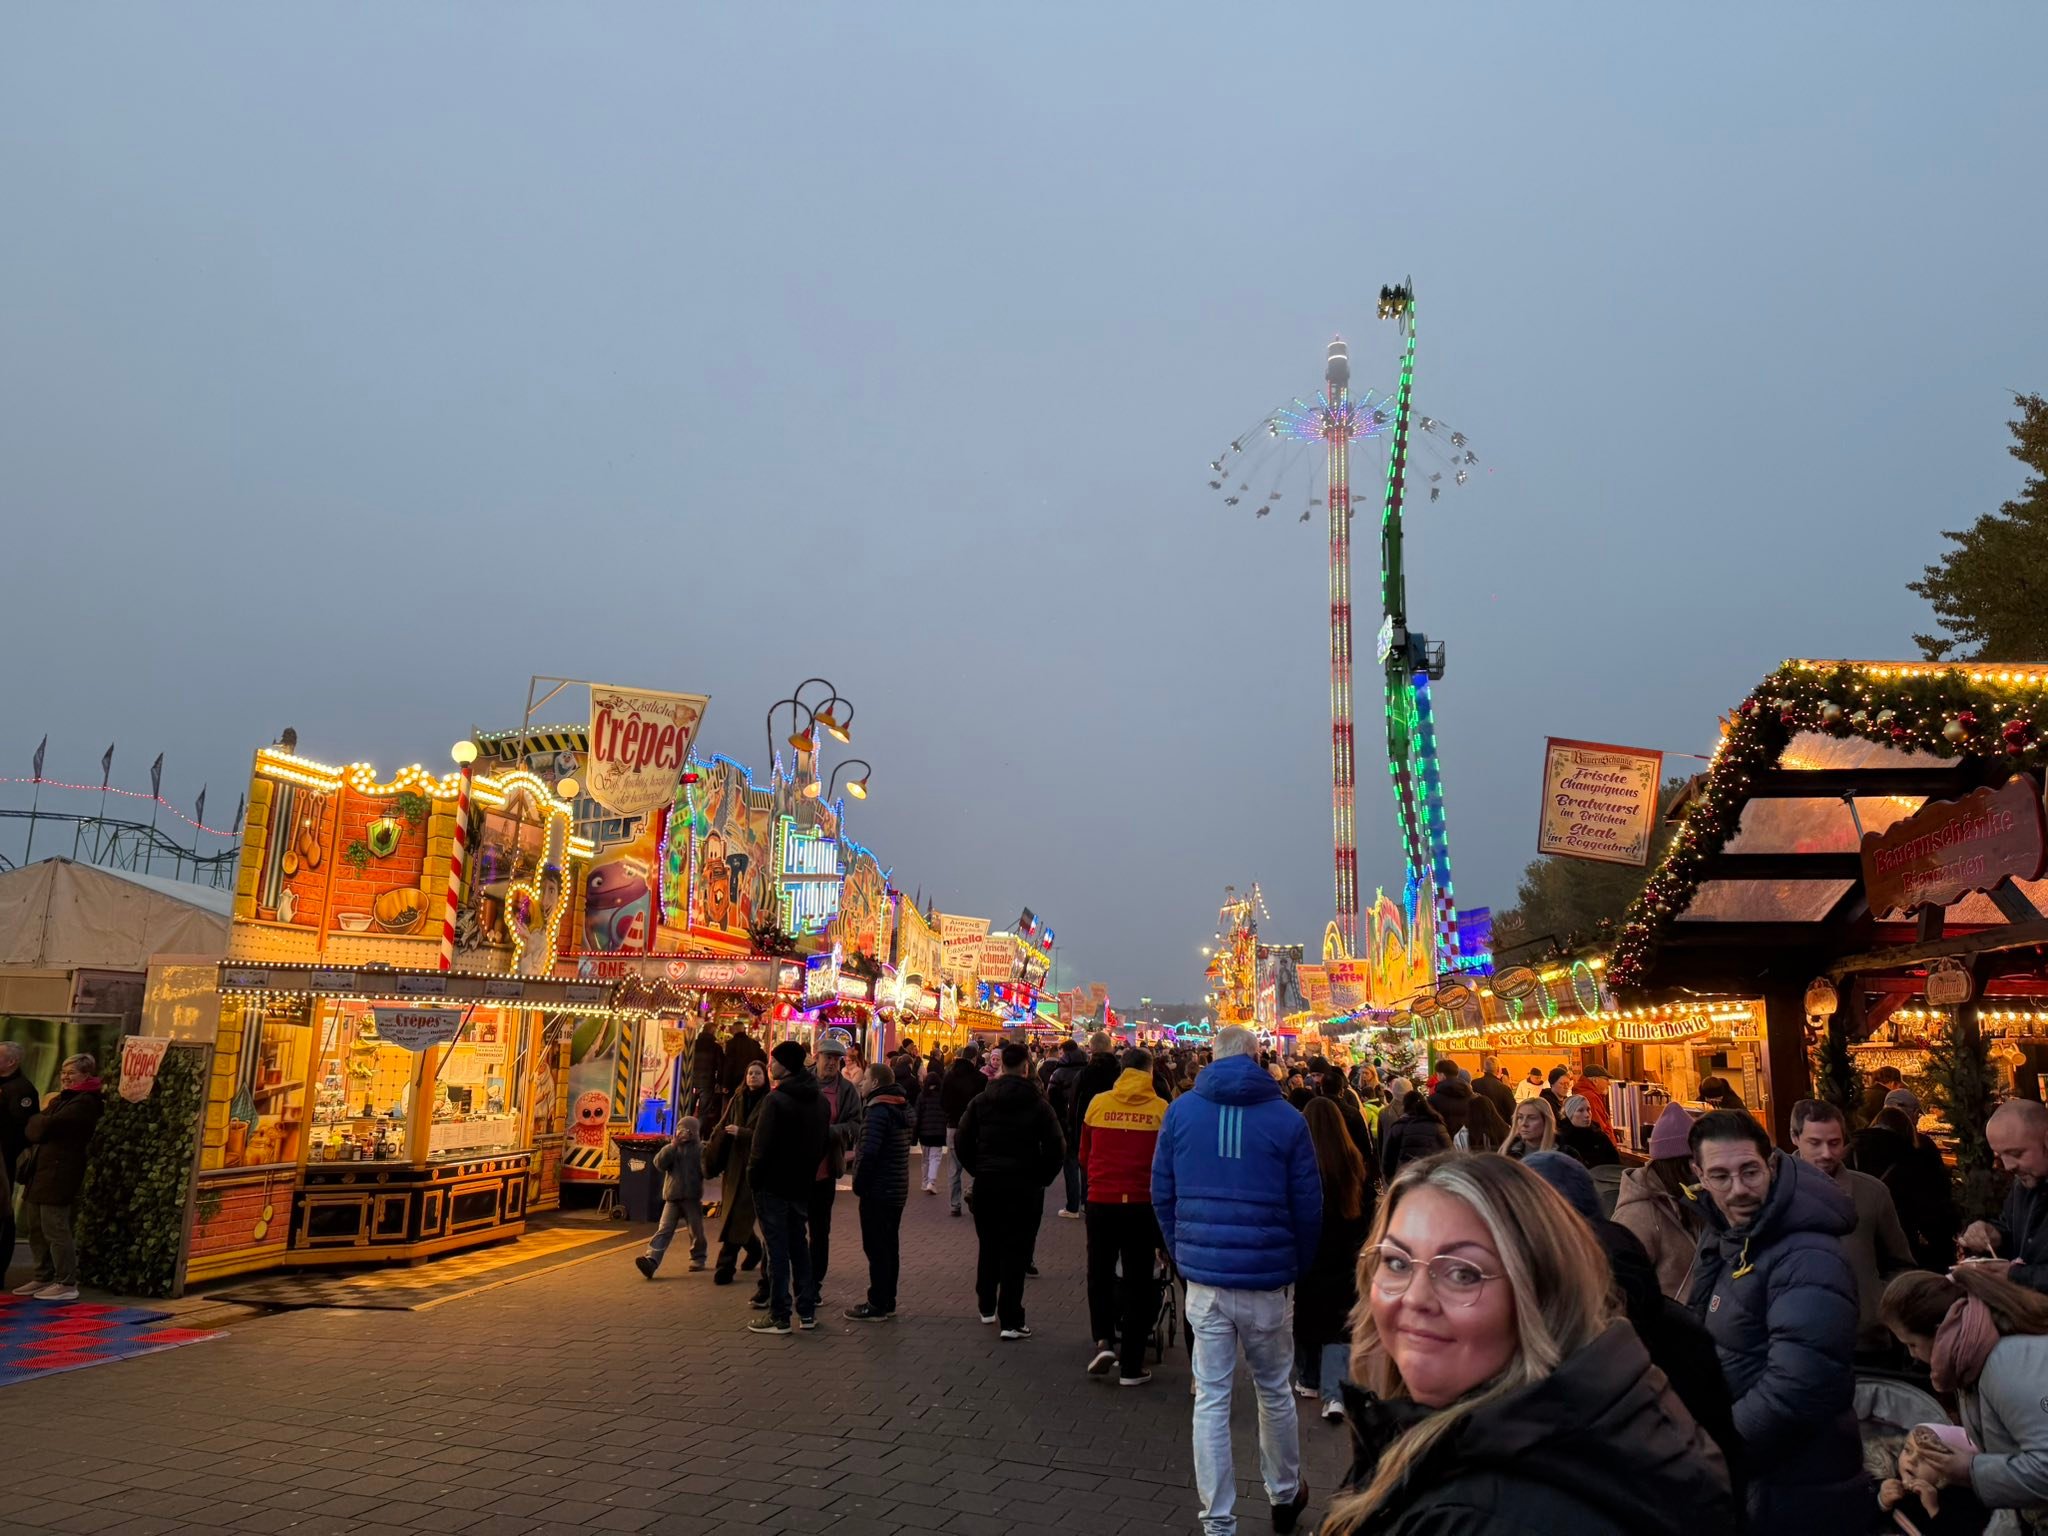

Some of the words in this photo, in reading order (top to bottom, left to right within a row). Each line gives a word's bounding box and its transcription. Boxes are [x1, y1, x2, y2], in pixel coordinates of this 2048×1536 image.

[594, 708, 690, 774] Crêpes
[1573, 767, 1627, 784] Frische
[1560, 778, 1639, 798] Champignons
[1555, 793, 1640, 816] Bratwurst
[1560, 807, 1574, 818] im
[1580, 810, 1627, 826] Brötchen
[1569, 823, 1617, 841] Steak
[1547, 833, 1562, 843] im
[1566, 835, 1637, 855] Roggenbrot
[1873, 808, 2015, 876] Bauernschänke
[943, 934, 983, 946] nutella
[701, 966, 735, 981] NICI
[980, 965, 1010, 977] kuchen
[1339, 963, 1354, 972] 21
[1329, 973, 1363, 983] ENTEN
[395, 1013, 441, 1029] Crêpes
[1616, 1014, 1709, 1041] Altbierbowle
